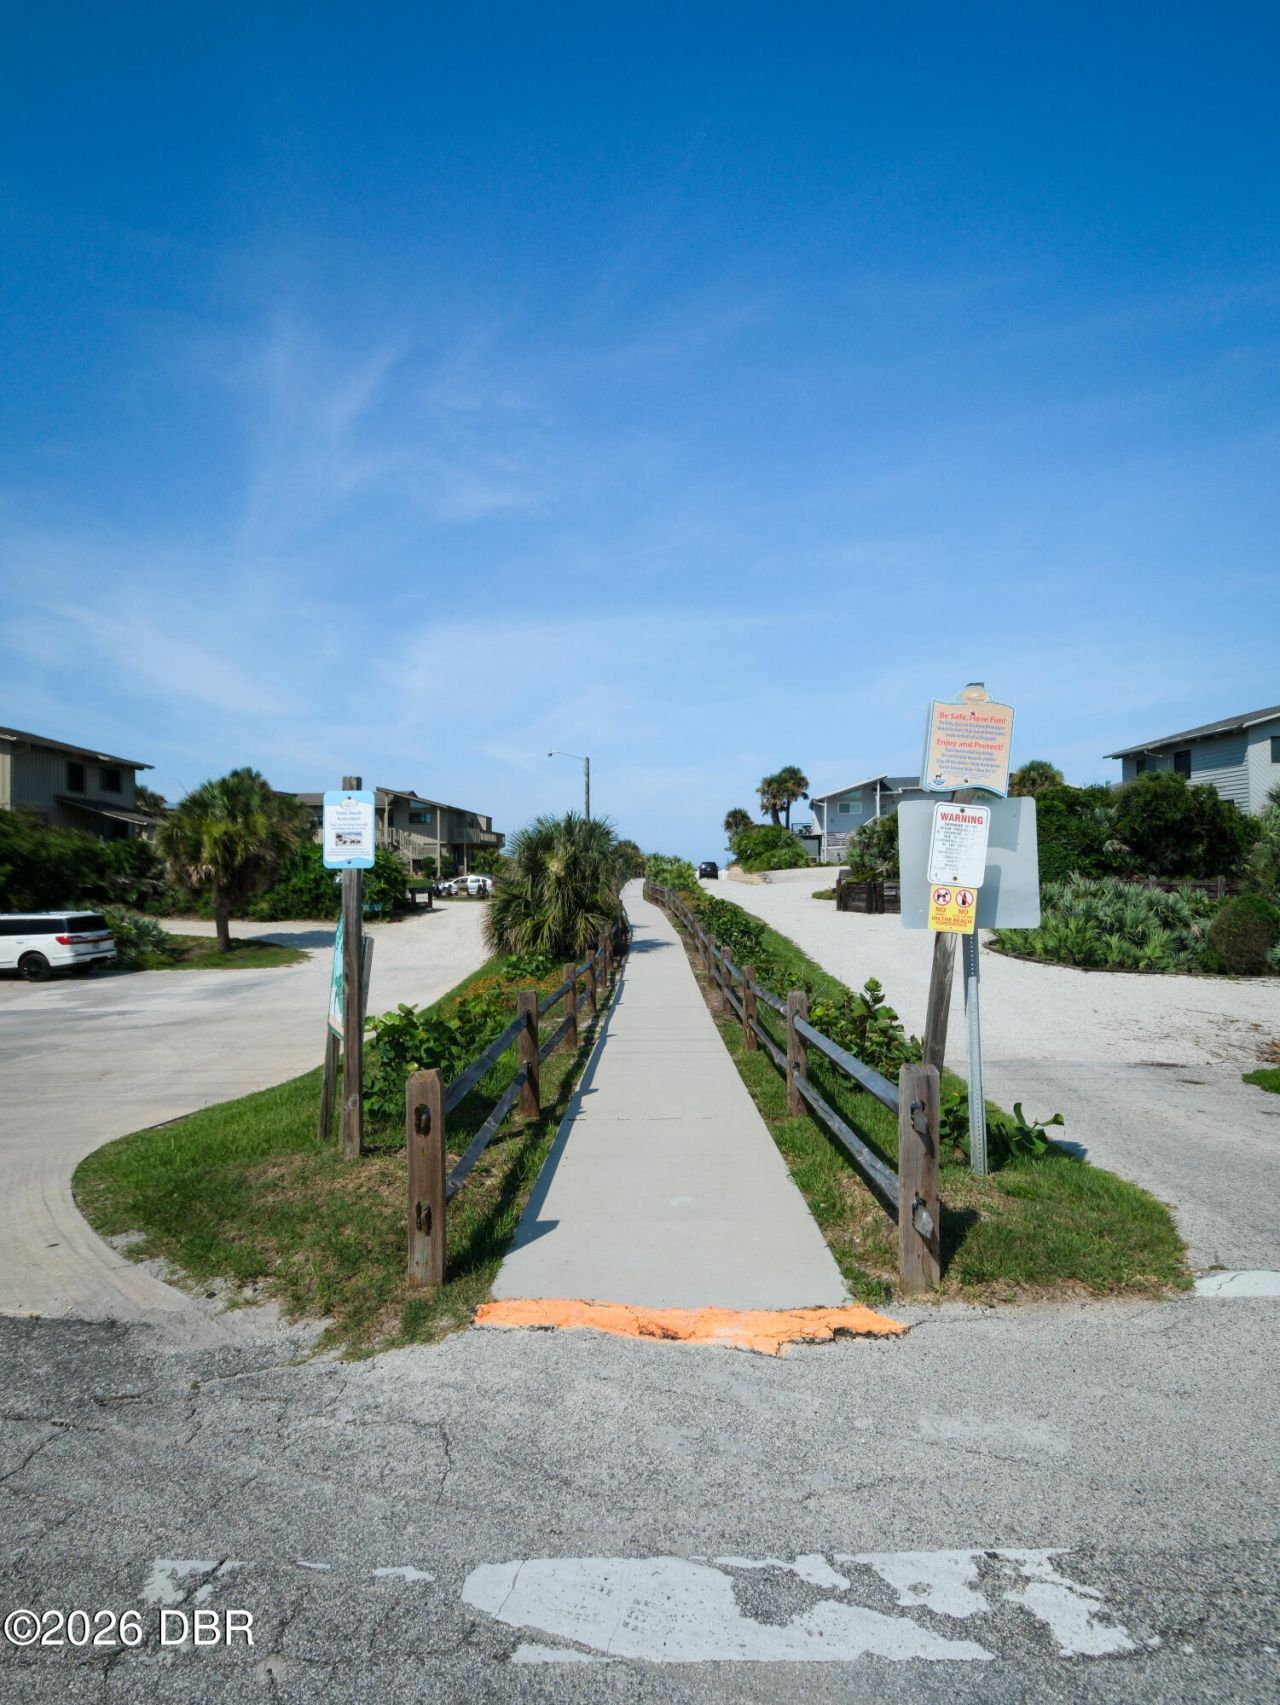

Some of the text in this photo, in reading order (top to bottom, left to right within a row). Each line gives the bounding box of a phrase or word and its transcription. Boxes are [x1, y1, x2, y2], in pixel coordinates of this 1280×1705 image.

[939, 712, 949, 720] Be
[969, 714, 988, 722] Have
[990, 716, 1006, 724] Fun!
[936, 738, 957, 748] Enjoy
[974, 742, 1003, 751] Protect!
[940, 812, 984, 825] WARNING
